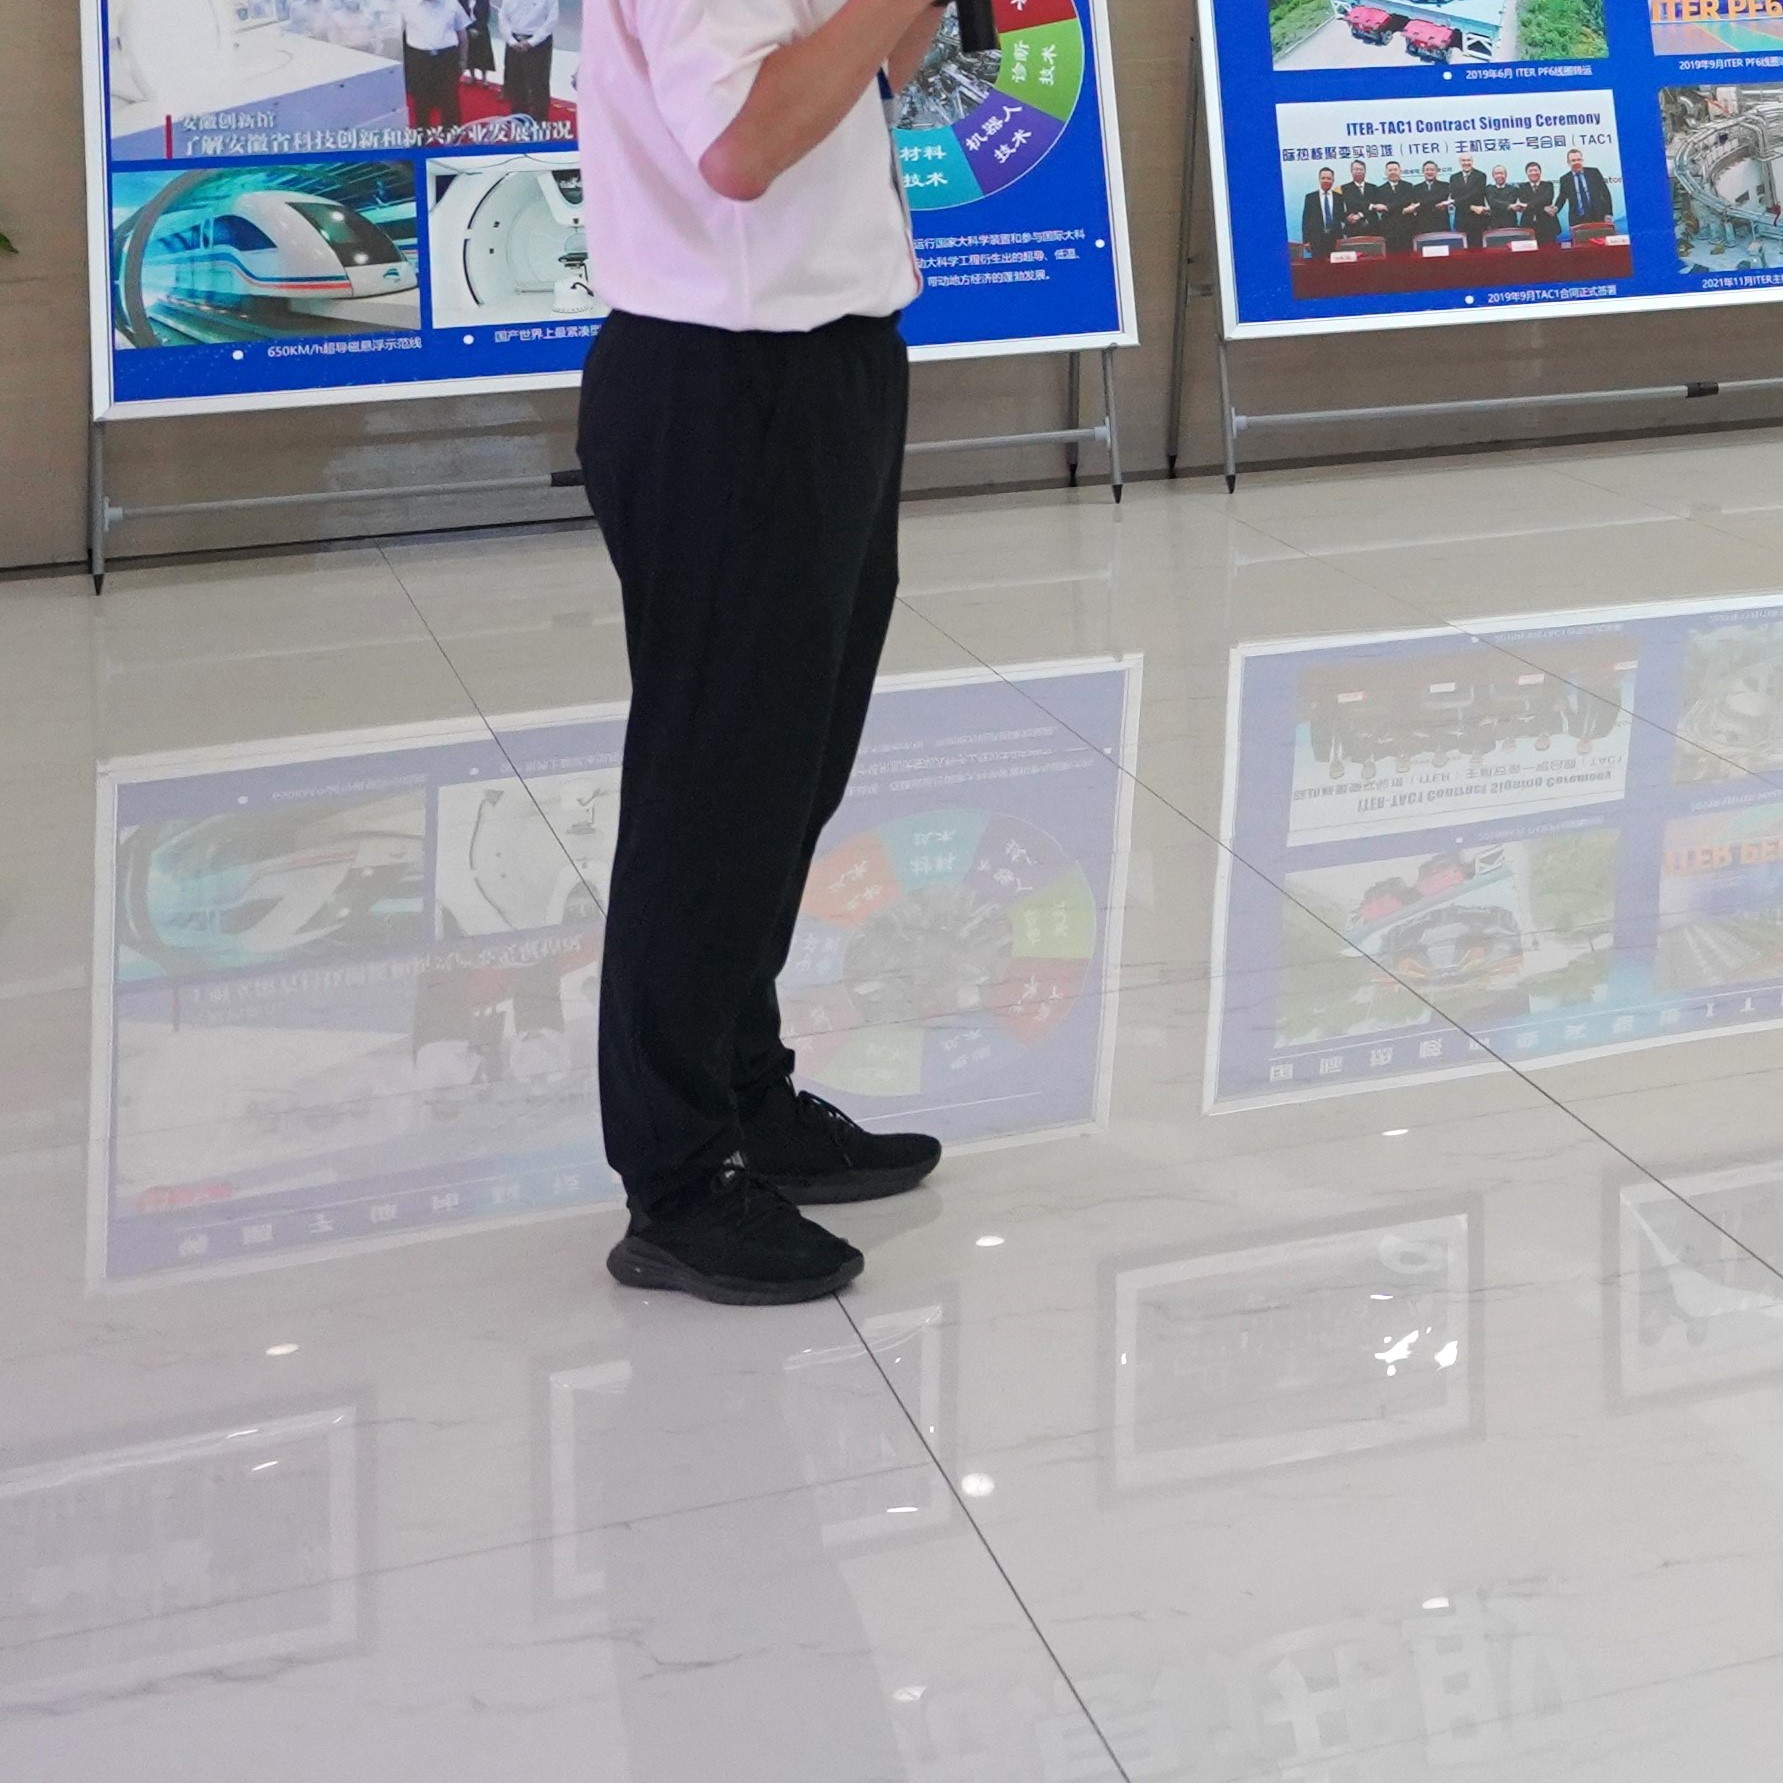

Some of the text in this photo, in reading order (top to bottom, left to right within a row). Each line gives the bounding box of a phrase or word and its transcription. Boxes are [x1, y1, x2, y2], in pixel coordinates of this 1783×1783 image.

[965, 103, 1023, 153] 机器人
[1345, 112, 1601, 137] ITER-TAC1 Contract Signing Ceremony
[993, 128, 1032, 165] 技术
